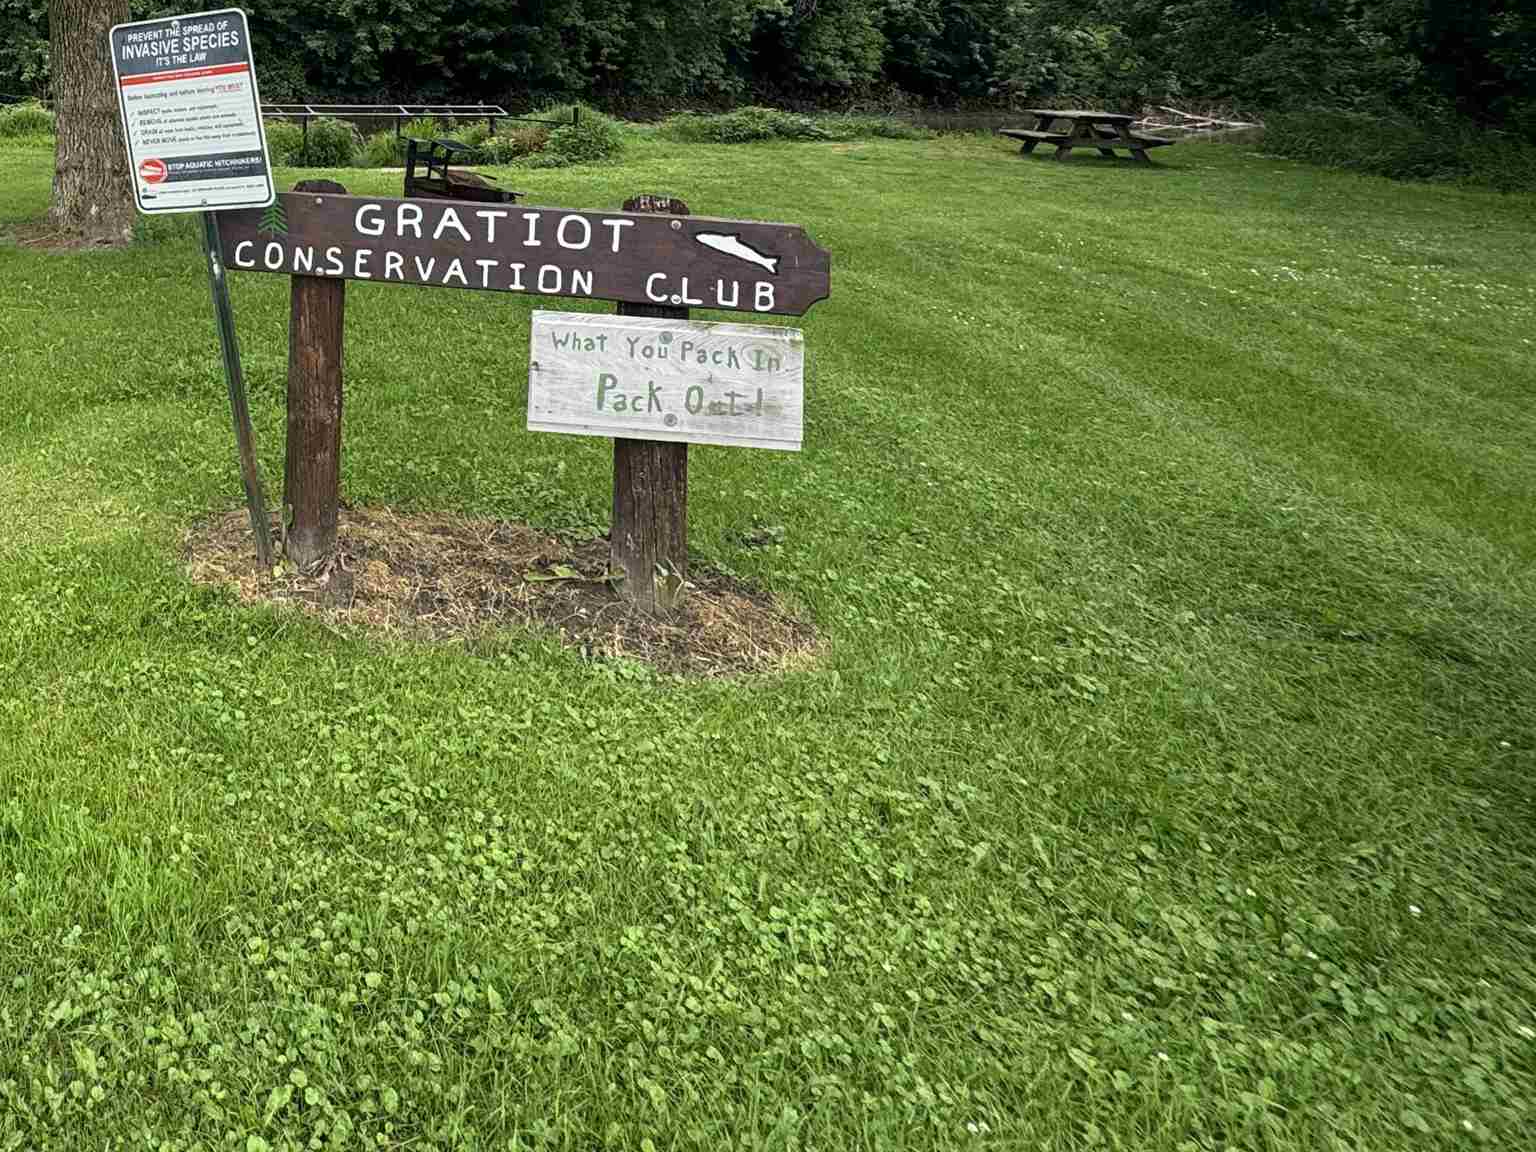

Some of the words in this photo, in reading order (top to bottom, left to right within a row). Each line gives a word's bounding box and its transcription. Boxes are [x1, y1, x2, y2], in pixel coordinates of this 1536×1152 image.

[122, 38, 179, 60] INVASIVE
[183, 30, 239, 52] SPECIES
[127, 30, 163, 43] PREVENT
[165, 26, 181, 38] THE
[183, 23, 215, 35] SPREAD
[217, 20, 228, 31] OF
[172, 55, 187, 64] THE
[189, 53, 207, 63] LAW
[168, 162, 184, 170] STOP
[185, 159, 213, 169] AQUATIC
[354, 203, 635, 252] GRATIOT
[235, 241, 593, 295] CONSERVATION
[646, 272, 775, 312] CLUB
[551, 332, 608, 353] What
[627, 336, 668, 360] You
[680, 340, 741, 369] Pack
[751, 349, 782, 373] In
[595, 373, 664, 414] Pack
